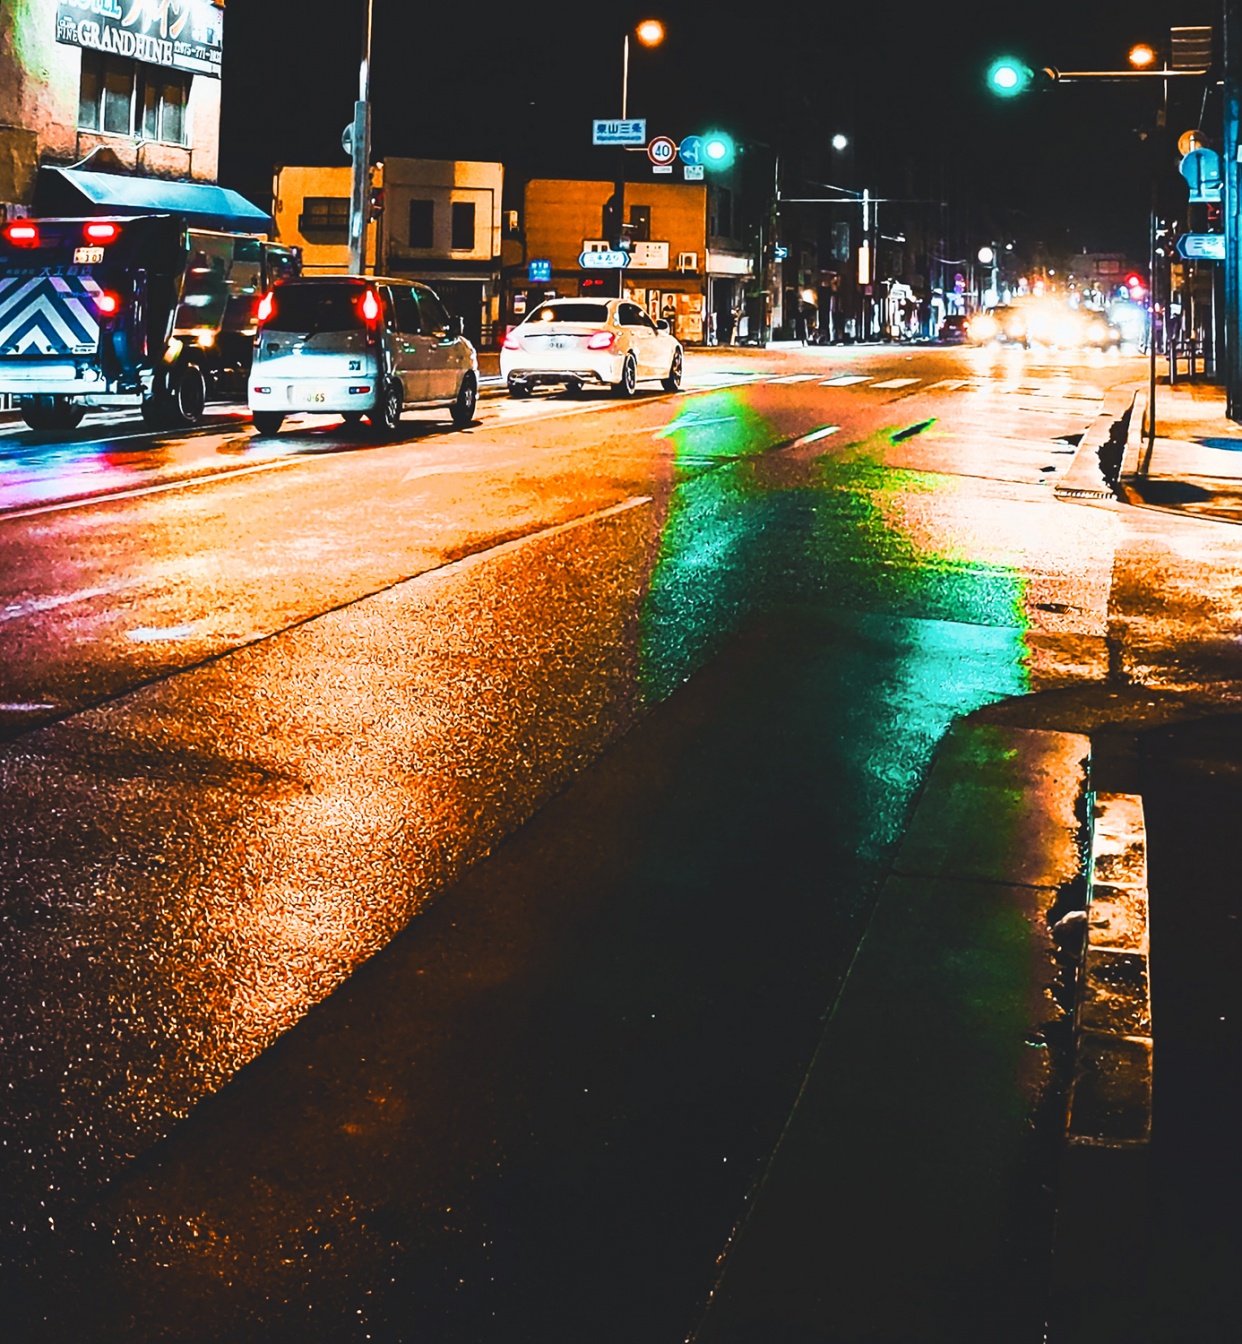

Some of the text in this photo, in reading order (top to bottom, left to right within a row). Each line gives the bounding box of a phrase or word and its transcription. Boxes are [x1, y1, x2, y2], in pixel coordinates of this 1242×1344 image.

[597, 123, 642, 134] 東山三条
[654, 144, 670, 158] 40
